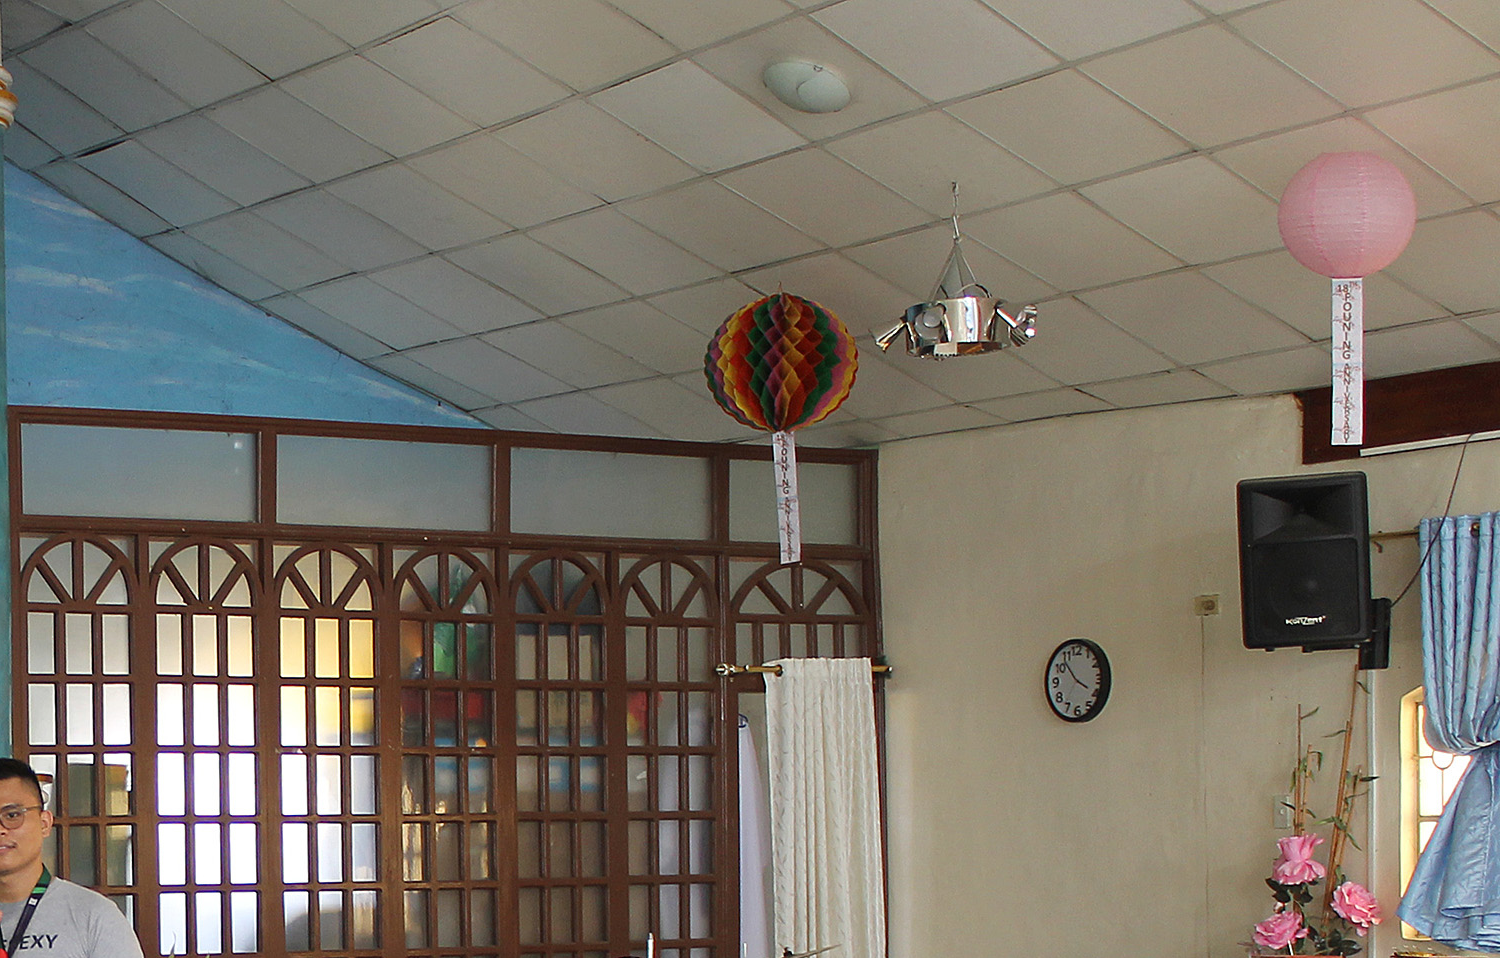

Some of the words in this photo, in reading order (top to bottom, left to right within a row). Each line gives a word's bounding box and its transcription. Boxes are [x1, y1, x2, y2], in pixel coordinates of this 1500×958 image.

[1072, 645, 1082, 656] 12
[1063, 651, 1071, 662] 11
[1056, 663, 1066, 673] 10
[1052, 677, 1060, 688] 9
[1056, 691, 1063, 703] 8
[1065, 702, 1071, 713] 7
[1074, 705, 1081, 716] 6
[1085, 701, 1092, 712] 5
[19, 934, 58, 950] EXY
